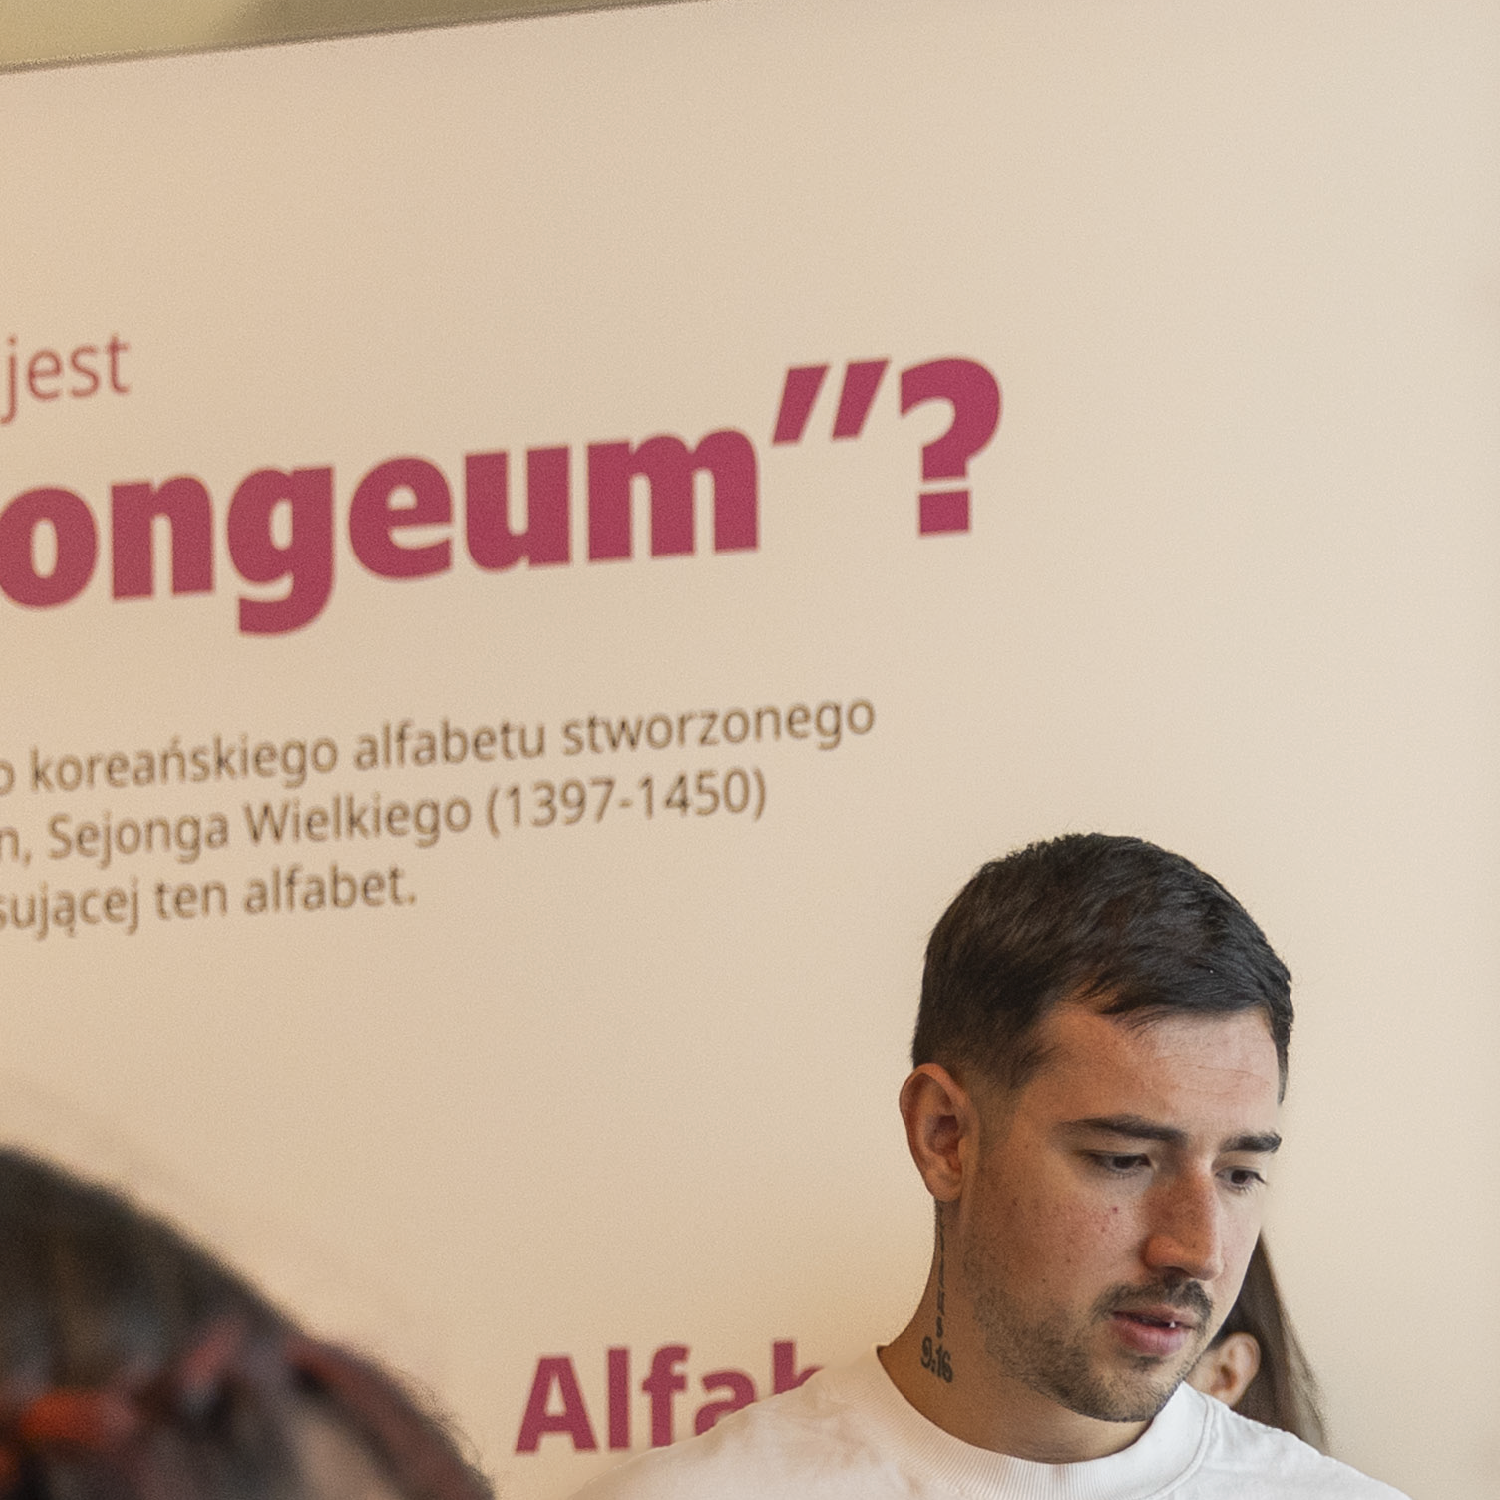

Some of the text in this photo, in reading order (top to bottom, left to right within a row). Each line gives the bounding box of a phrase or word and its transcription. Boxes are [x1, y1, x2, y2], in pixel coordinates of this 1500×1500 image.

[0, 334, 131, 425] jest
[30, 731, 338, 793] koreańskiego
[354, 719, 545, 771] alfabetu
[562, 699, 875, 757] stworzonego
[48, 812, 229, 870] Sejonga
[244, 785, 472, 849] Wielkiego
[485, 768, 766, 838] (1397-1450)
[154, 882, 228, 920] ten
[243, 863, 416, 915] alfabet.
